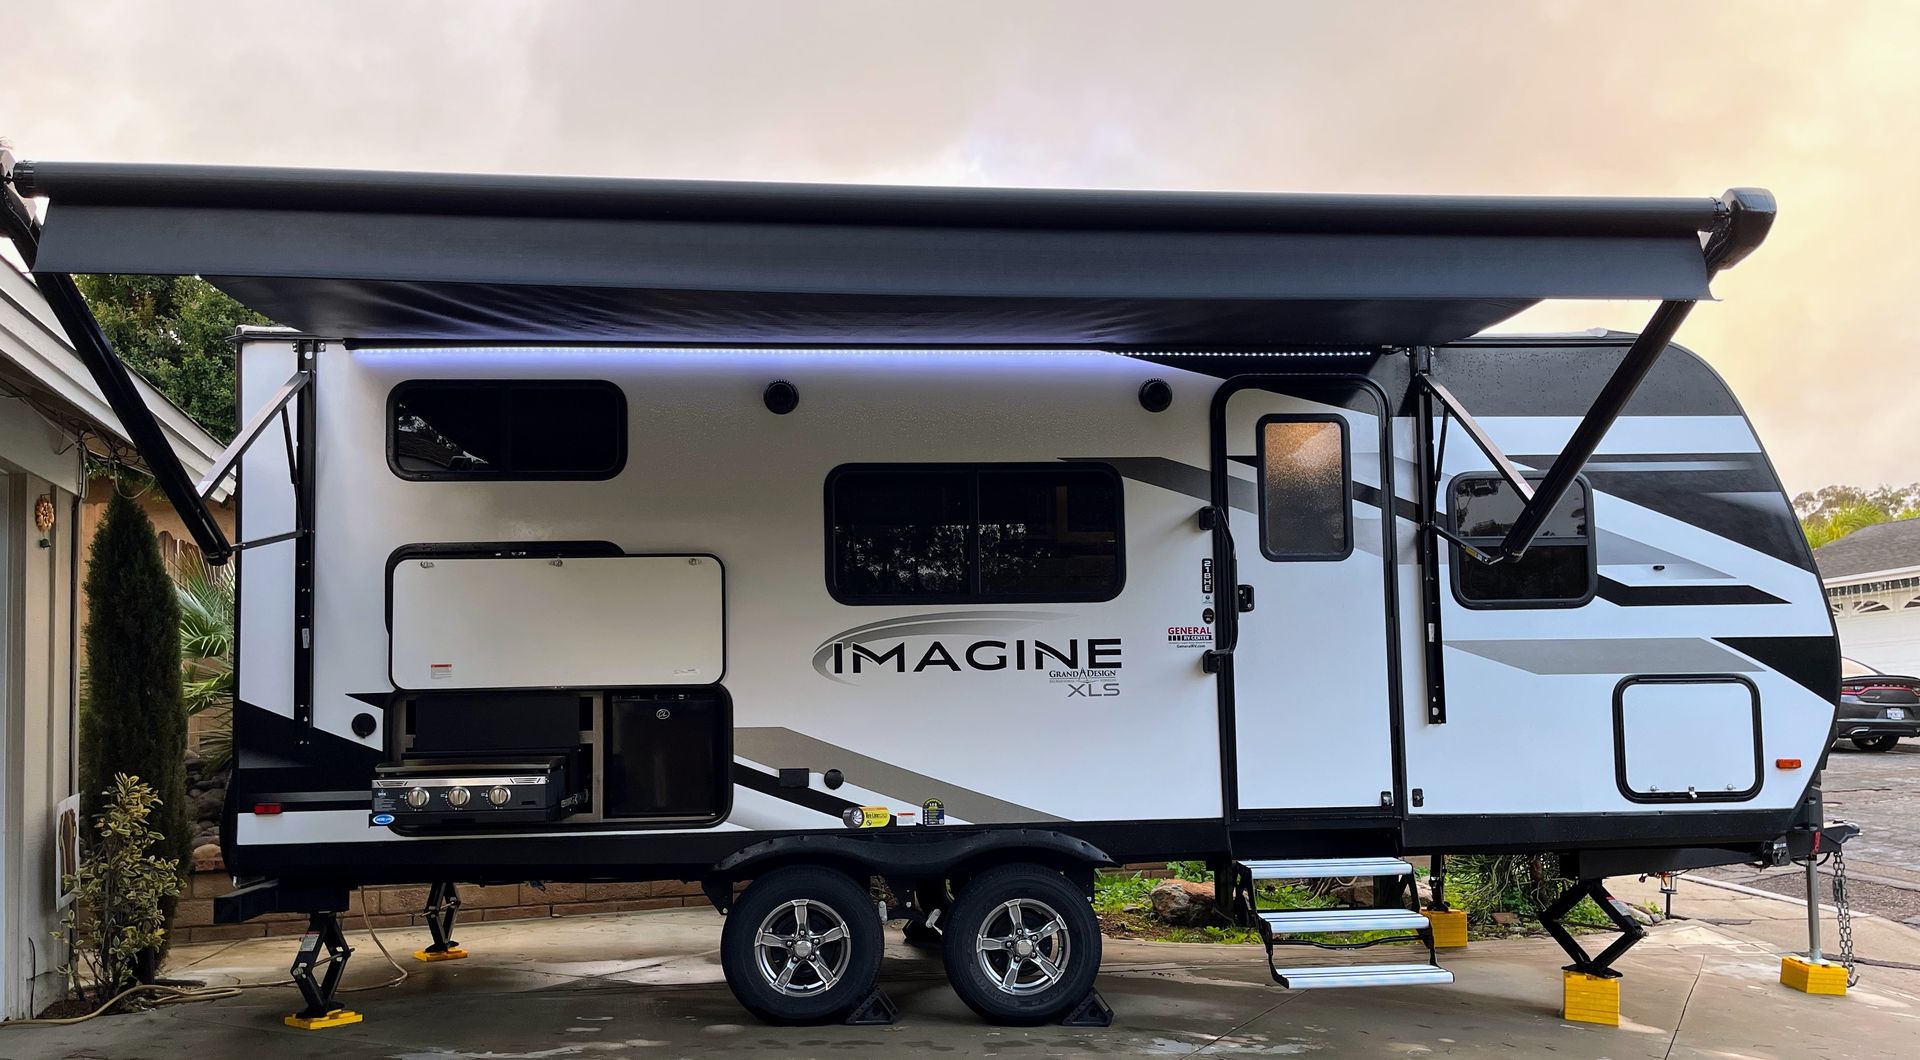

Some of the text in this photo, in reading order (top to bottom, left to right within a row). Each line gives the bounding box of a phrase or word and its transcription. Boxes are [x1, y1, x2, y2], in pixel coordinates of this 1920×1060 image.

[1168, 627, 1212, 635] GENERAL
[833, 639, 1122, 674] IMAGINE
[1067, 683, 1120, 697] XLS
